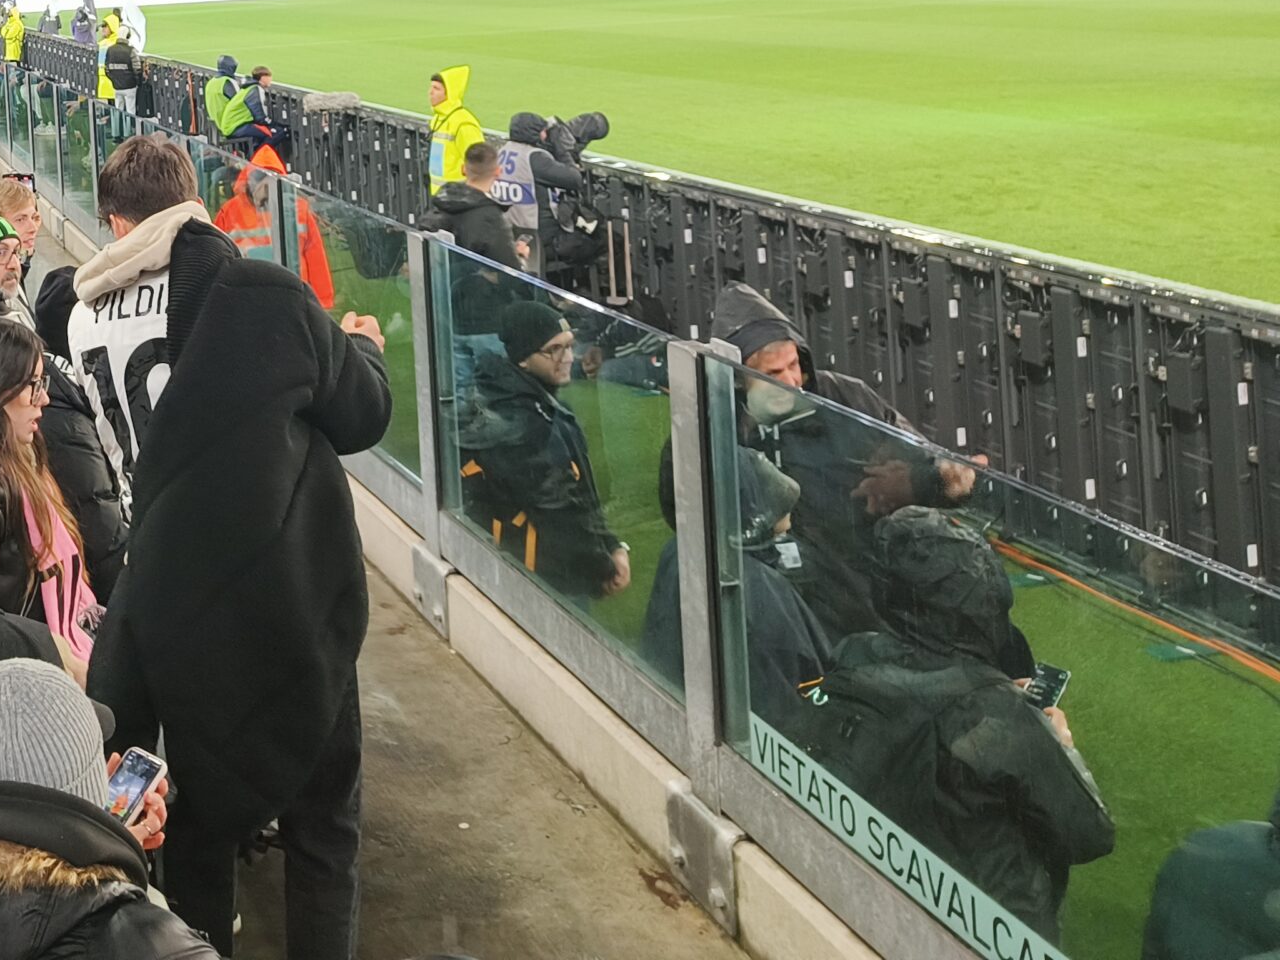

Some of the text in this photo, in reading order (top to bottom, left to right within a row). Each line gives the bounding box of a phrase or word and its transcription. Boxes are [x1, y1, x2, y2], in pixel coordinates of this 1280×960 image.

[490, 180, 523, 203] OTO
[93, 283, 169, 324] YILDI
[753, 723, 1056, 960] VIETATO SCAVALCA
